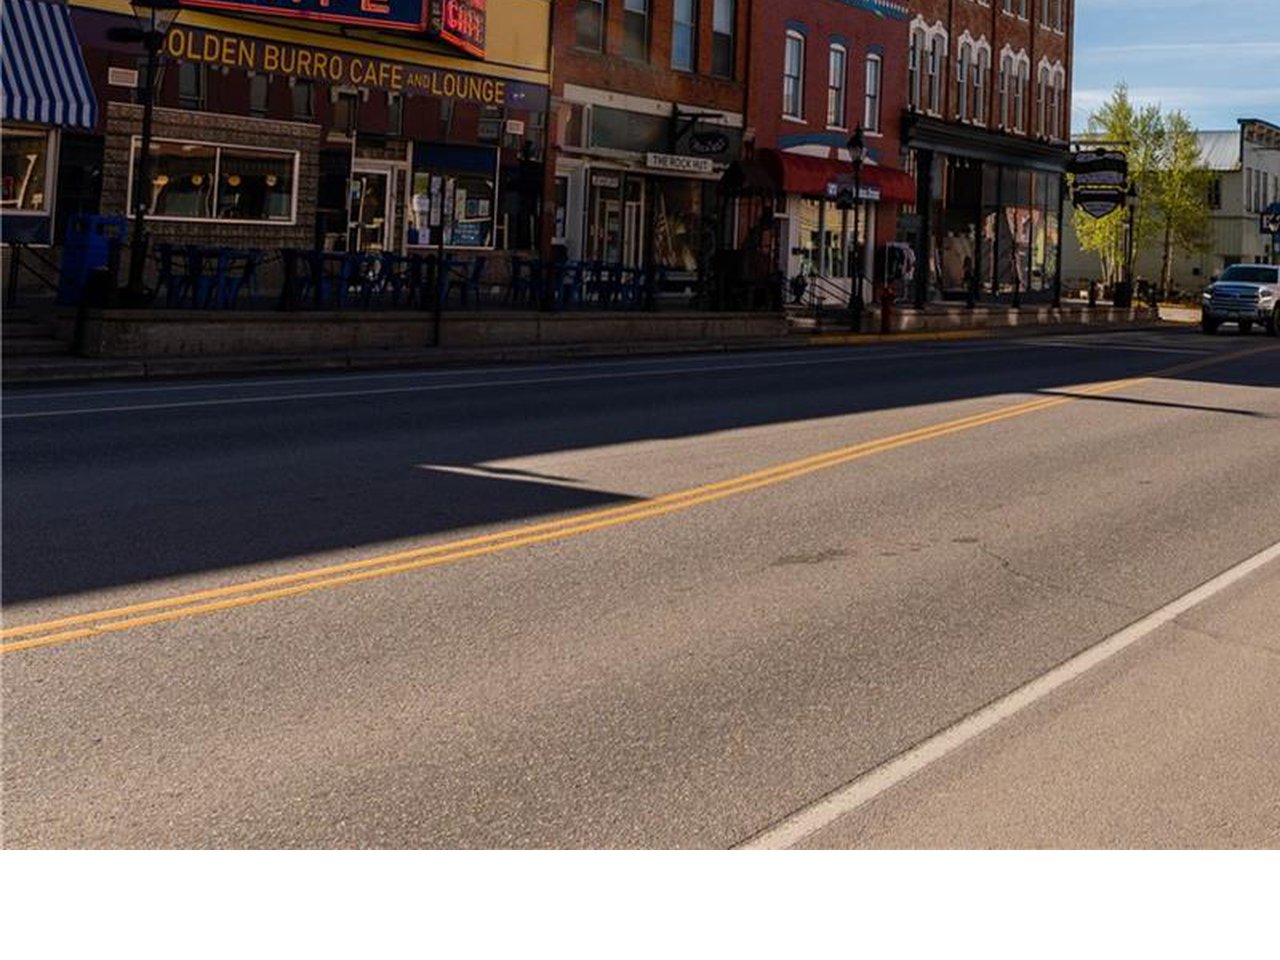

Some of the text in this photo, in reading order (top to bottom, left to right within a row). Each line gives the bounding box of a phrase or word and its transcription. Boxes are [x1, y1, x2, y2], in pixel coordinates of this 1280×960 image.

[162, 28, 505, 104] OLDEN BURRO CAFE AND LOUNGE
